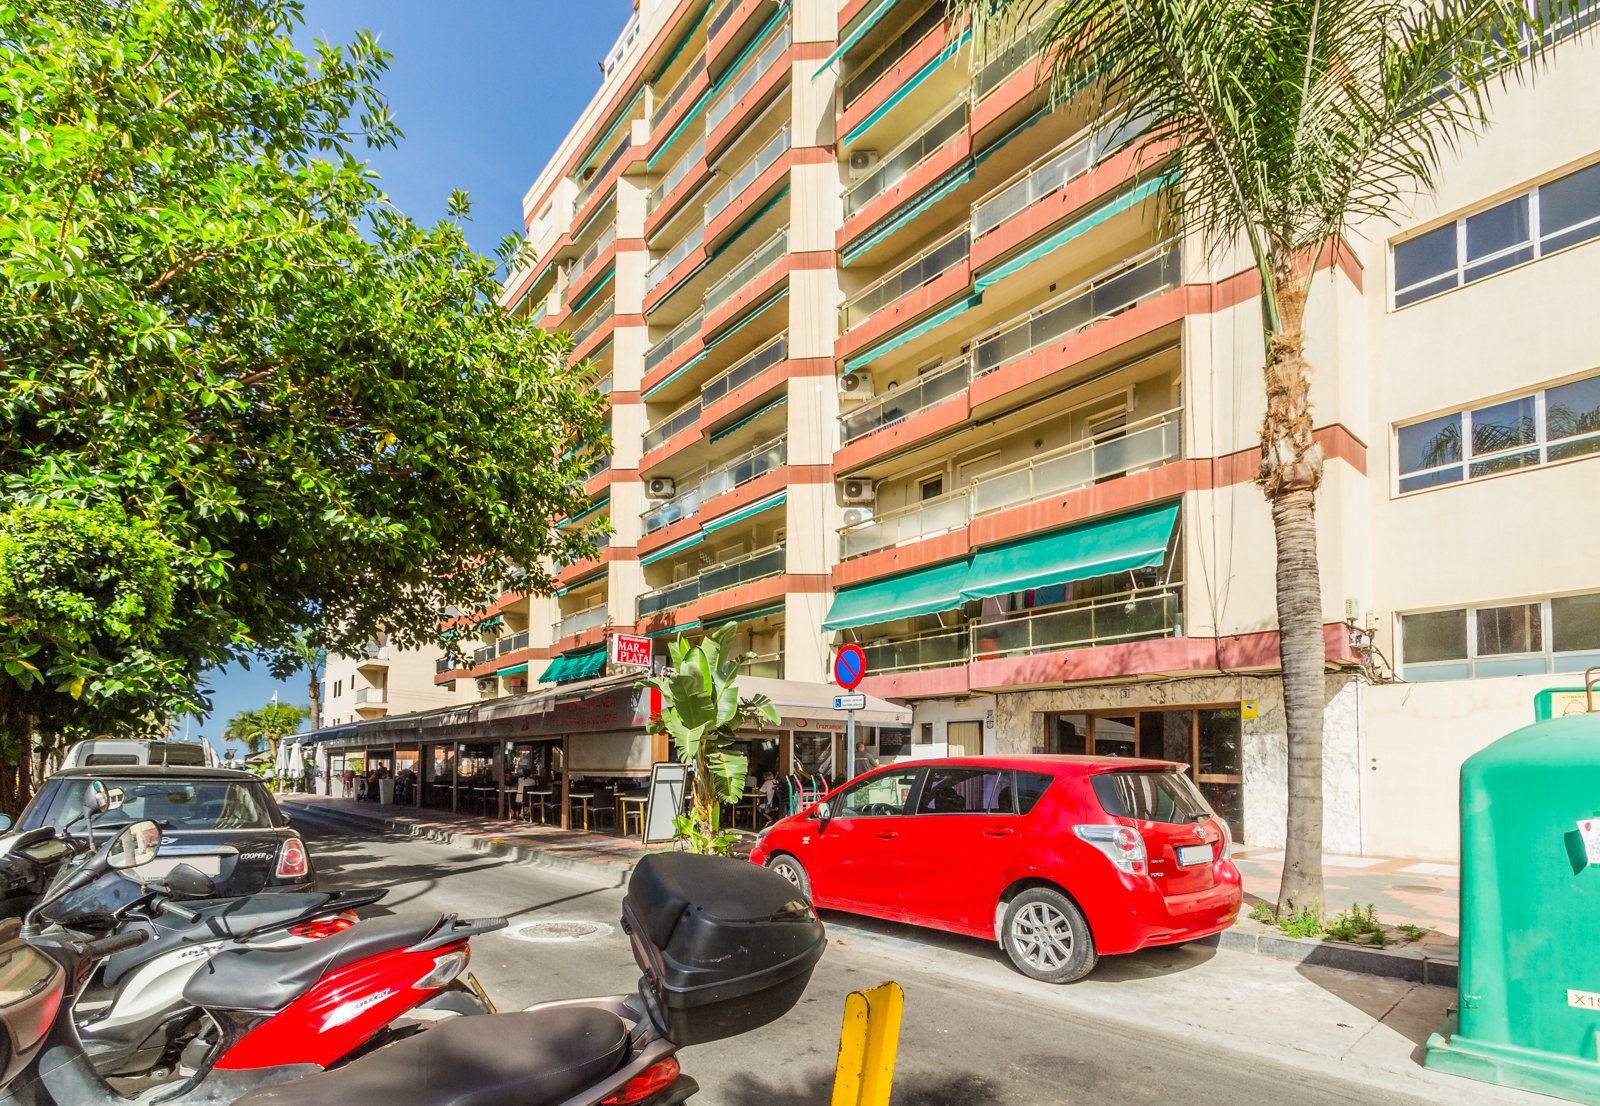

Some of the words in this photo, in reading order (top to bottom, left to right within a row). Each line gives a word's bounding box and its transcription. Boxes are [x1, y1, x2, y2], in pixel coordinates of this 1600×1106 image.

[618, 641, 640, 652] MAR
[620, 651, 649, 664] PLATA
[815, 722, 843, 731] Cruzcampo
